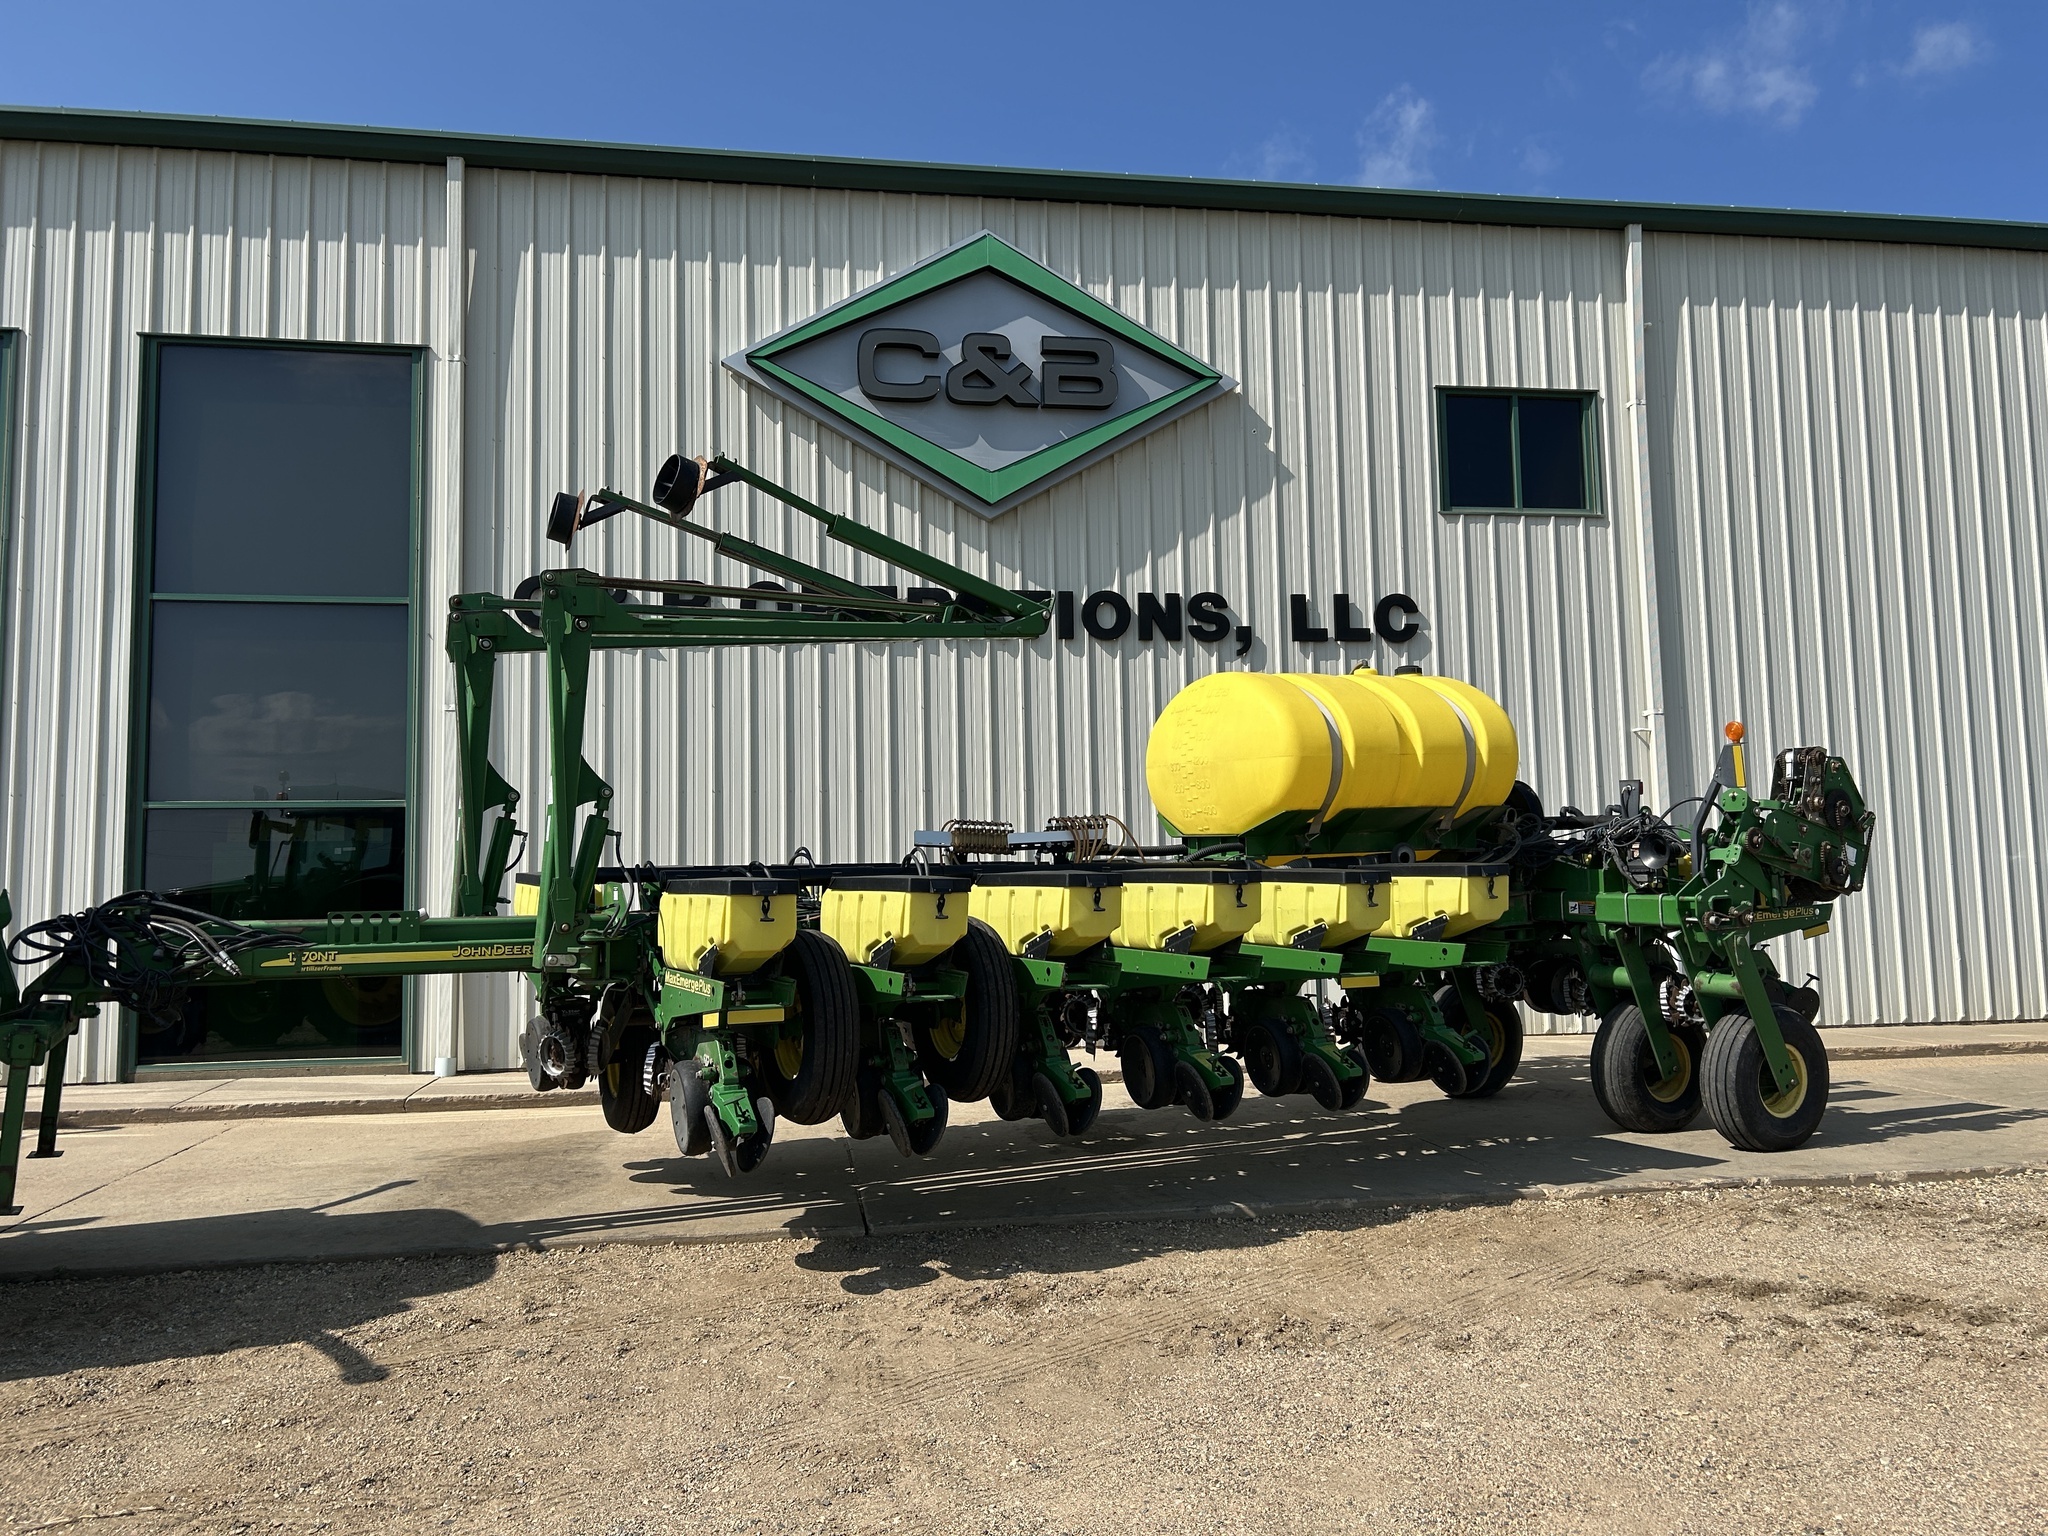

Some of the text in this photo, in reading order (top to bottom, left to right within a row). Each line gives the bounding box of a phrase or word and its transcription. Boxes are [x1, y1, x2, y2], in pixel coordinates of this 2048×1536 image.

[857, 328, 1119, 409] C&B
[1291, 593, 1419, 643] LLC
[493, 944, 535, 956] DEER
[665, 970, 711, 995] MaxEmergePlus
